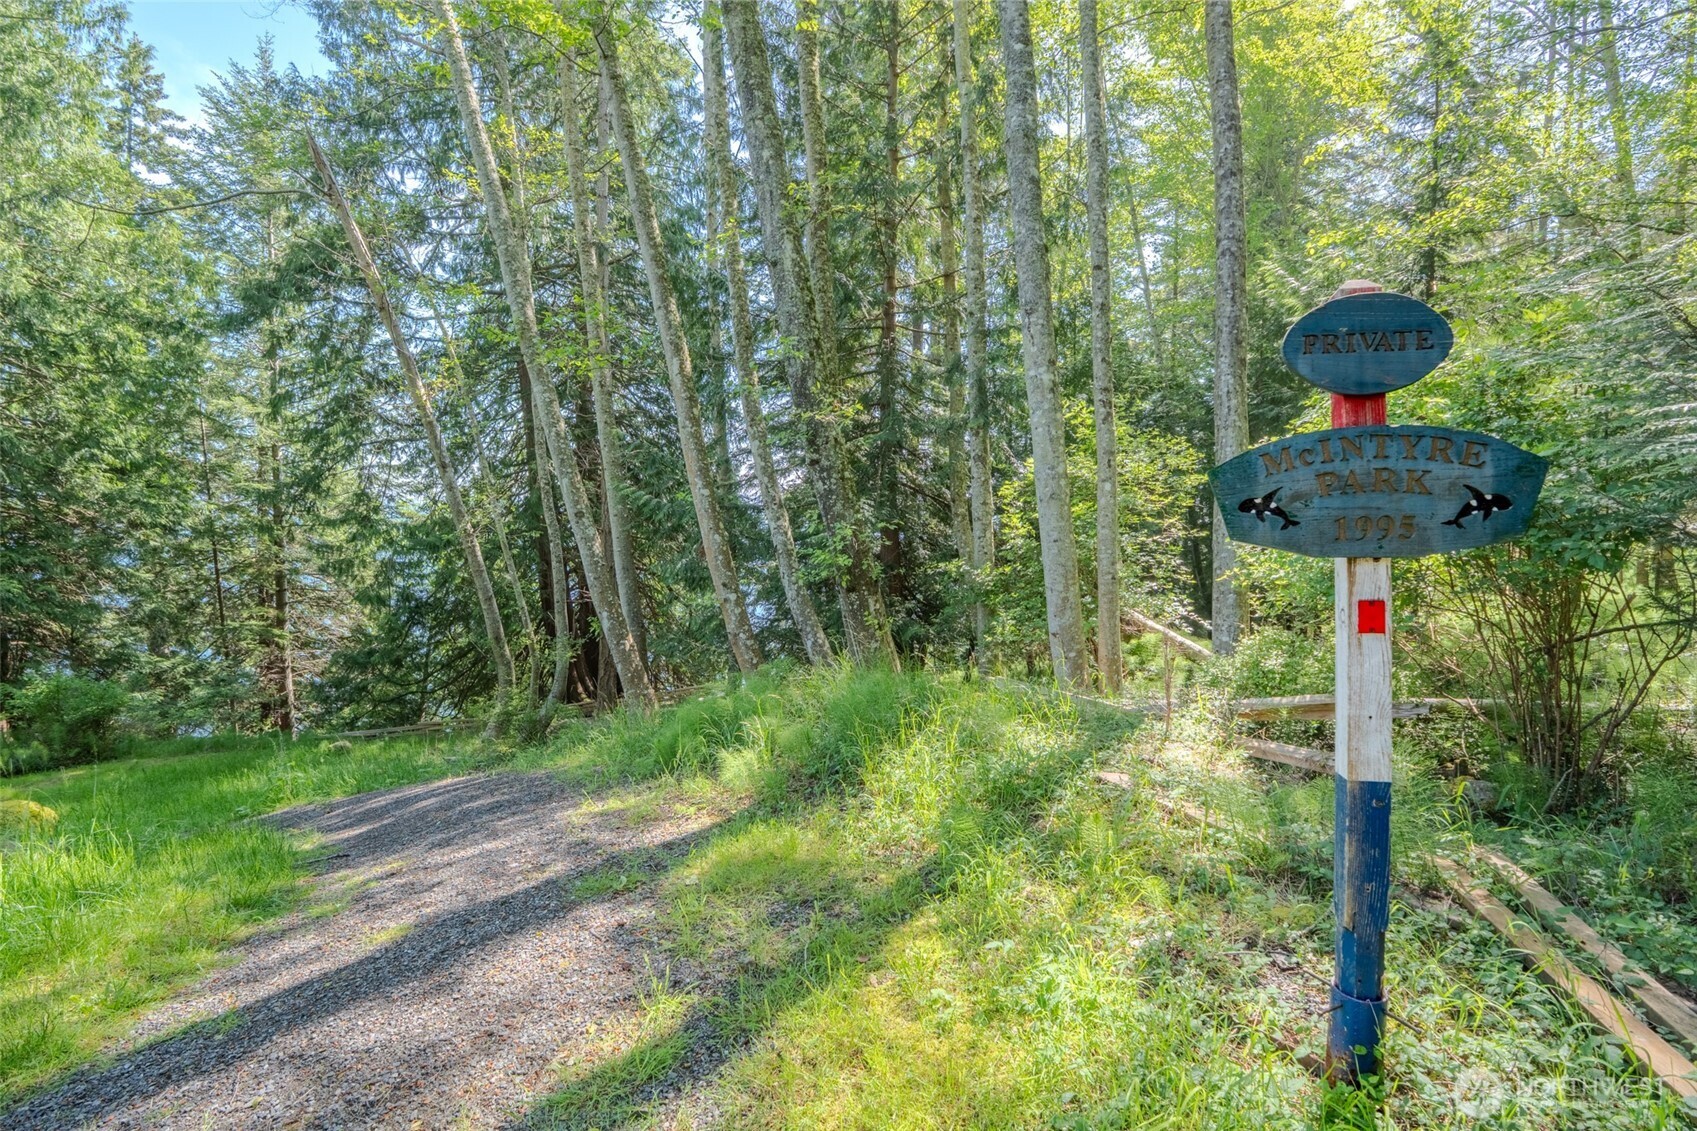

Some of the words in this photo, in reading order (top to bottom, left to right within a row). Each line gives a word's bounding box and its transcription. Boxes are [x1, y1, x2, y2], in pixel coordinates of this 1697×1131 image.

[1302, 330, 1434, 355] PRIVATE
[1258, 433, 1489, 477] McINTYRE
[1315, 467, 1433, 497] PARK
[1334, 514, 1416, 542] 1995
